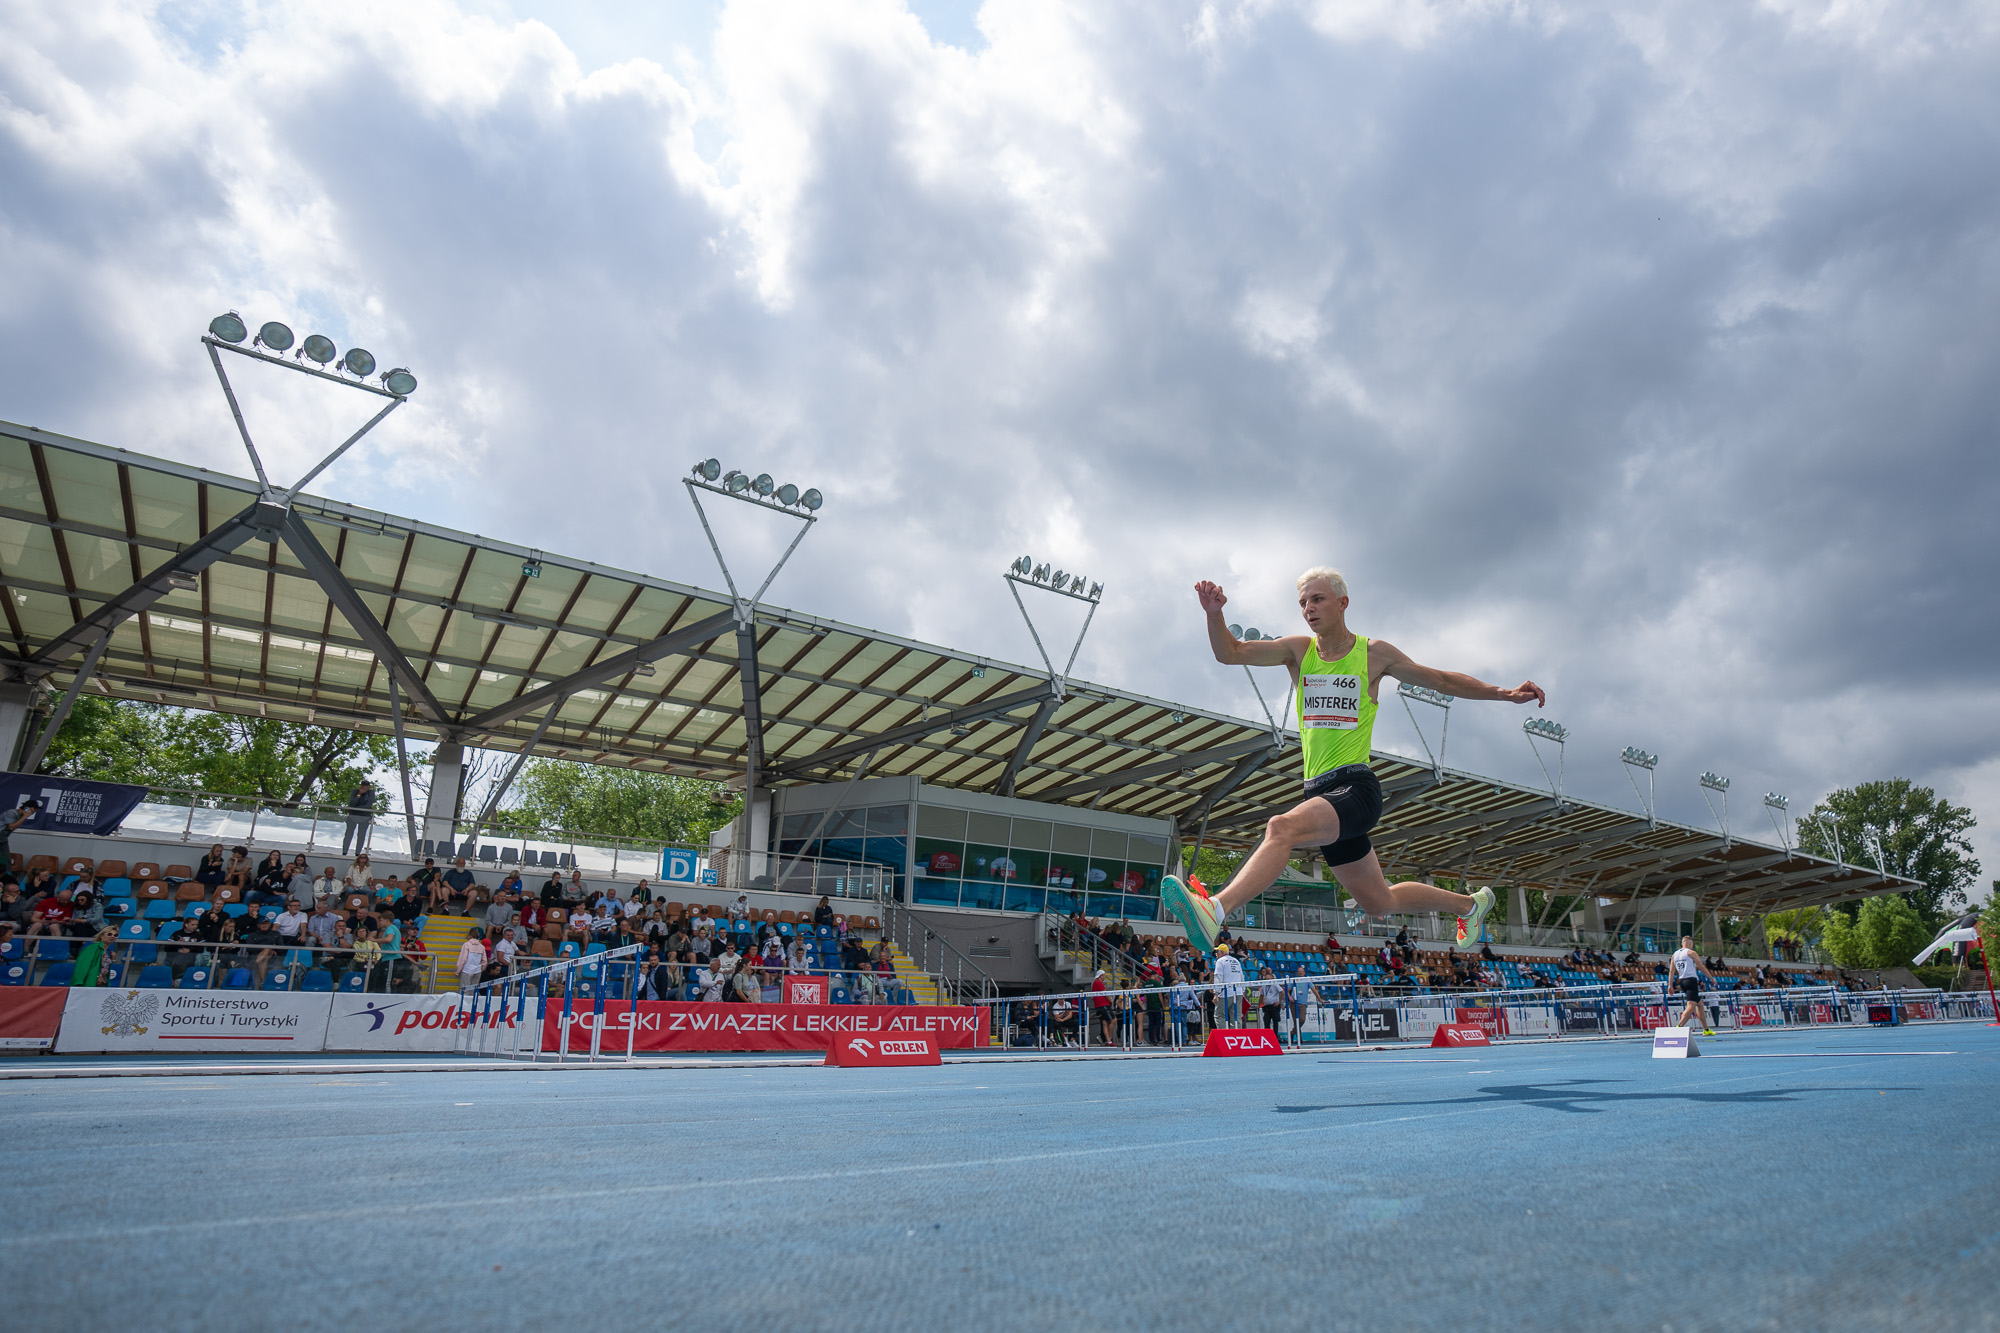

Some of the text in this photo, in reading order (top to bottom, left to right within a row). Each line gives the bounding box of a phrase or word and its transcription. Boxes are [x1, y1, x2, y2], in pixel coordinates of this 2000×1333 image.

[1332, 677, 1356, 689] 466
[1304, 696, 1358, 711] MISTEREK
[62, 790, 103, 801] AKADEMICKIE
[59, 803, 99, 813] SZKOLENIA
[60, 797, 102, 807] CENTRUM
[57, 810, 98, 819] SPORTOWEGO
[64, 817, 96, 826] LUBLINIE
[669, 857, 690, 879] D
[703, 871, 717, 879] WC
[165, 996, 269, 1010] Ministerstwo
[1339, 1009, 1353, 1021] 4F
[1640, 1007, 1664, 1020] PZLA
[1738, 1006, 1756, 1018] ZLA
[161, 1012, 299, 1028] Sportu i Turystyki
[394, 1004, 519, 1035] polanik
[557, 1010, 979, 1034] POLSKI ZWIĄZEK LEKKIEJ ATLETYKI
[1463, 1031, 1483, 1039] ORLEN
[883, 1042, 925, 1053] ORLEN
[1224, 1036, 1274, 1050] PZLA
